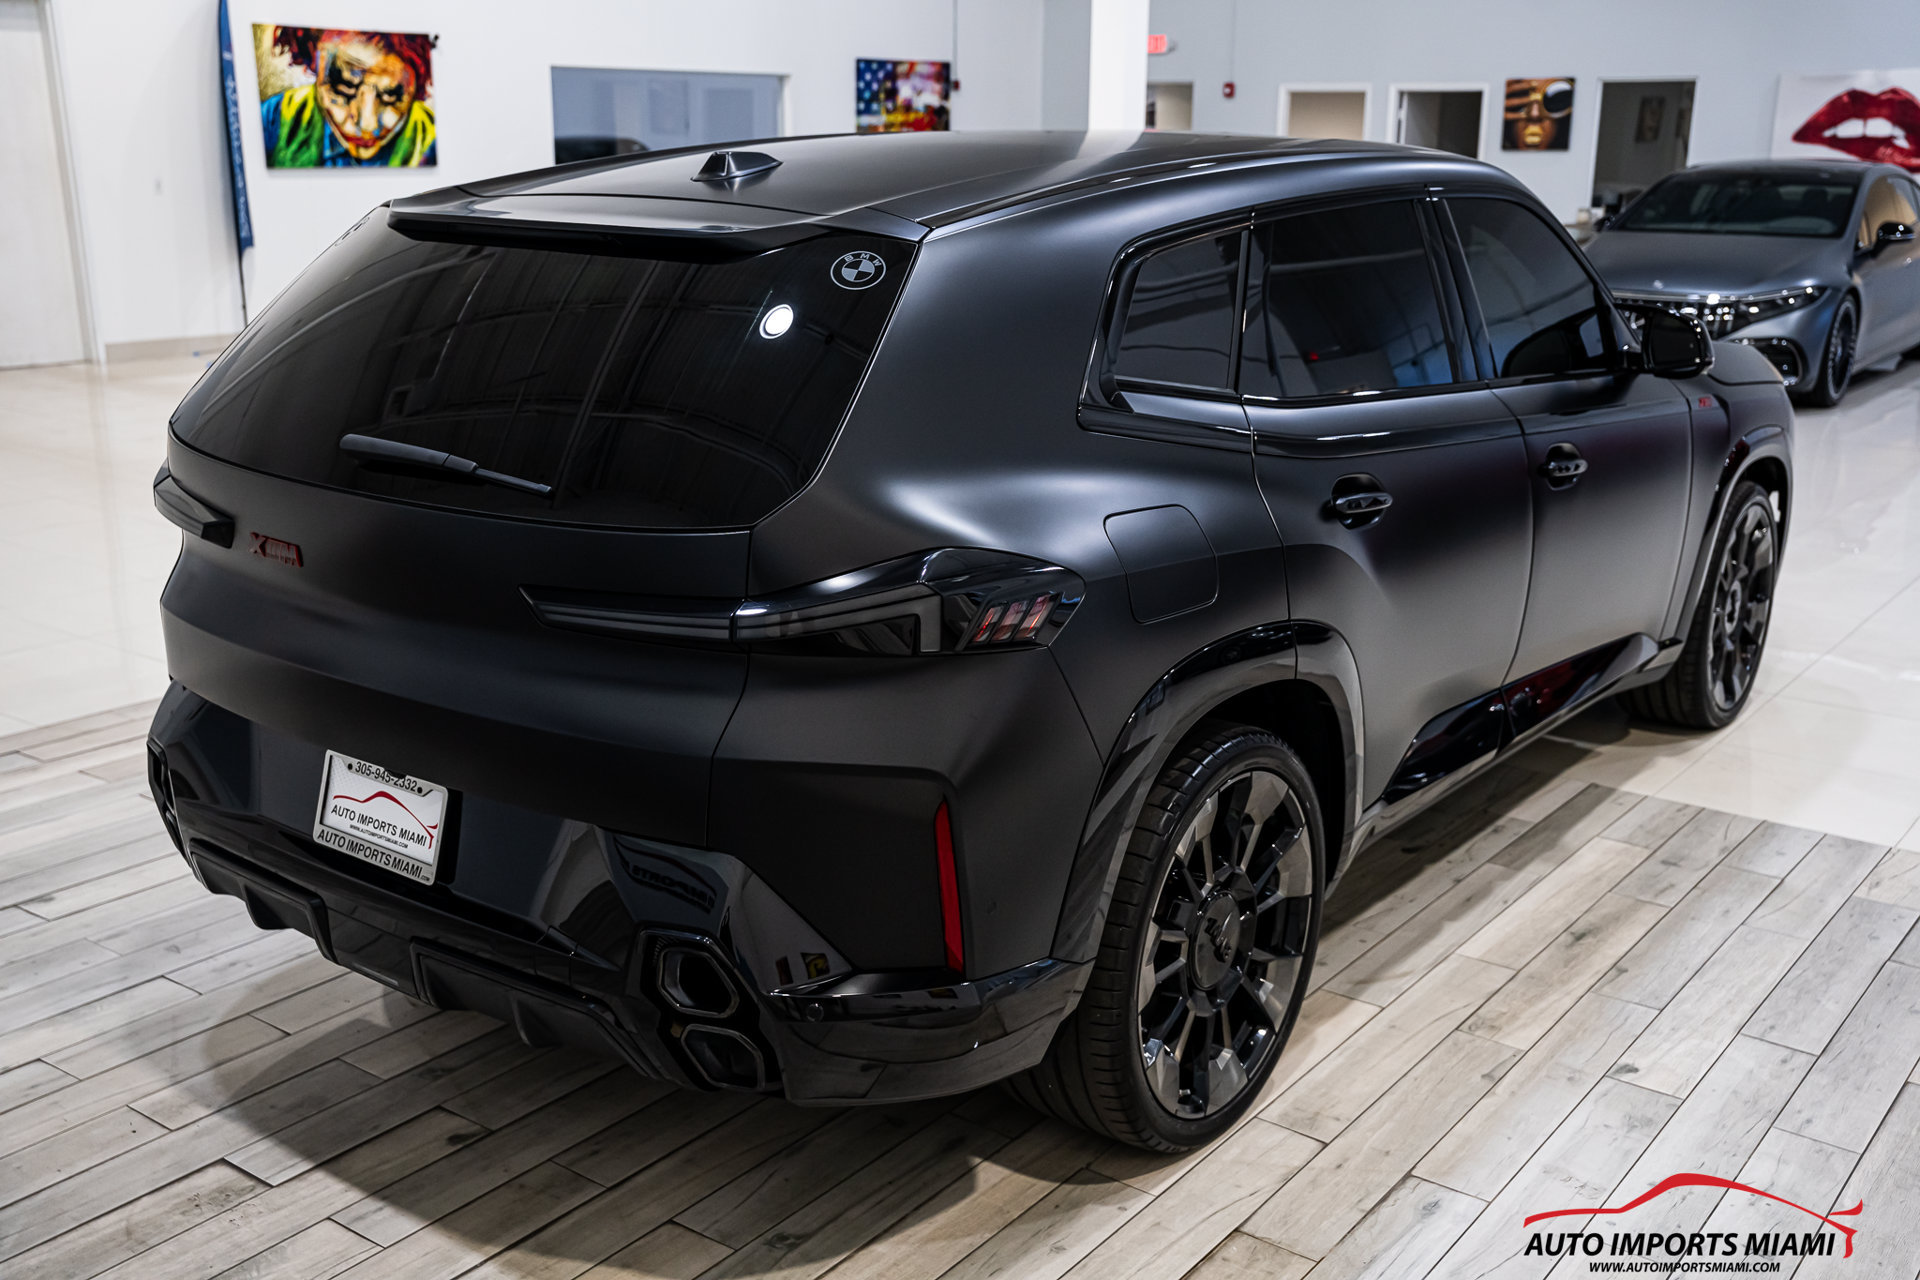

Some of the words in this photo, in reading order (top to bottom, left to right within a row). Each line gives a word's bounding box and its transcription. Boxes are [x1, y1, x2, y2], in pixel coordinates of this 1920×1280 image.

[844, 253, 882, 267] BMW
[355, 761, 418, 792] 305-945-2332
[331, 804, 355, 821] AUTO
[357, 813, 398, 836] IMPORTS
[399, 829, 427, 847] MIAMI
[317, 829, 346, 848] AUTO
[346, 839, 392, 866] IMPORTS
